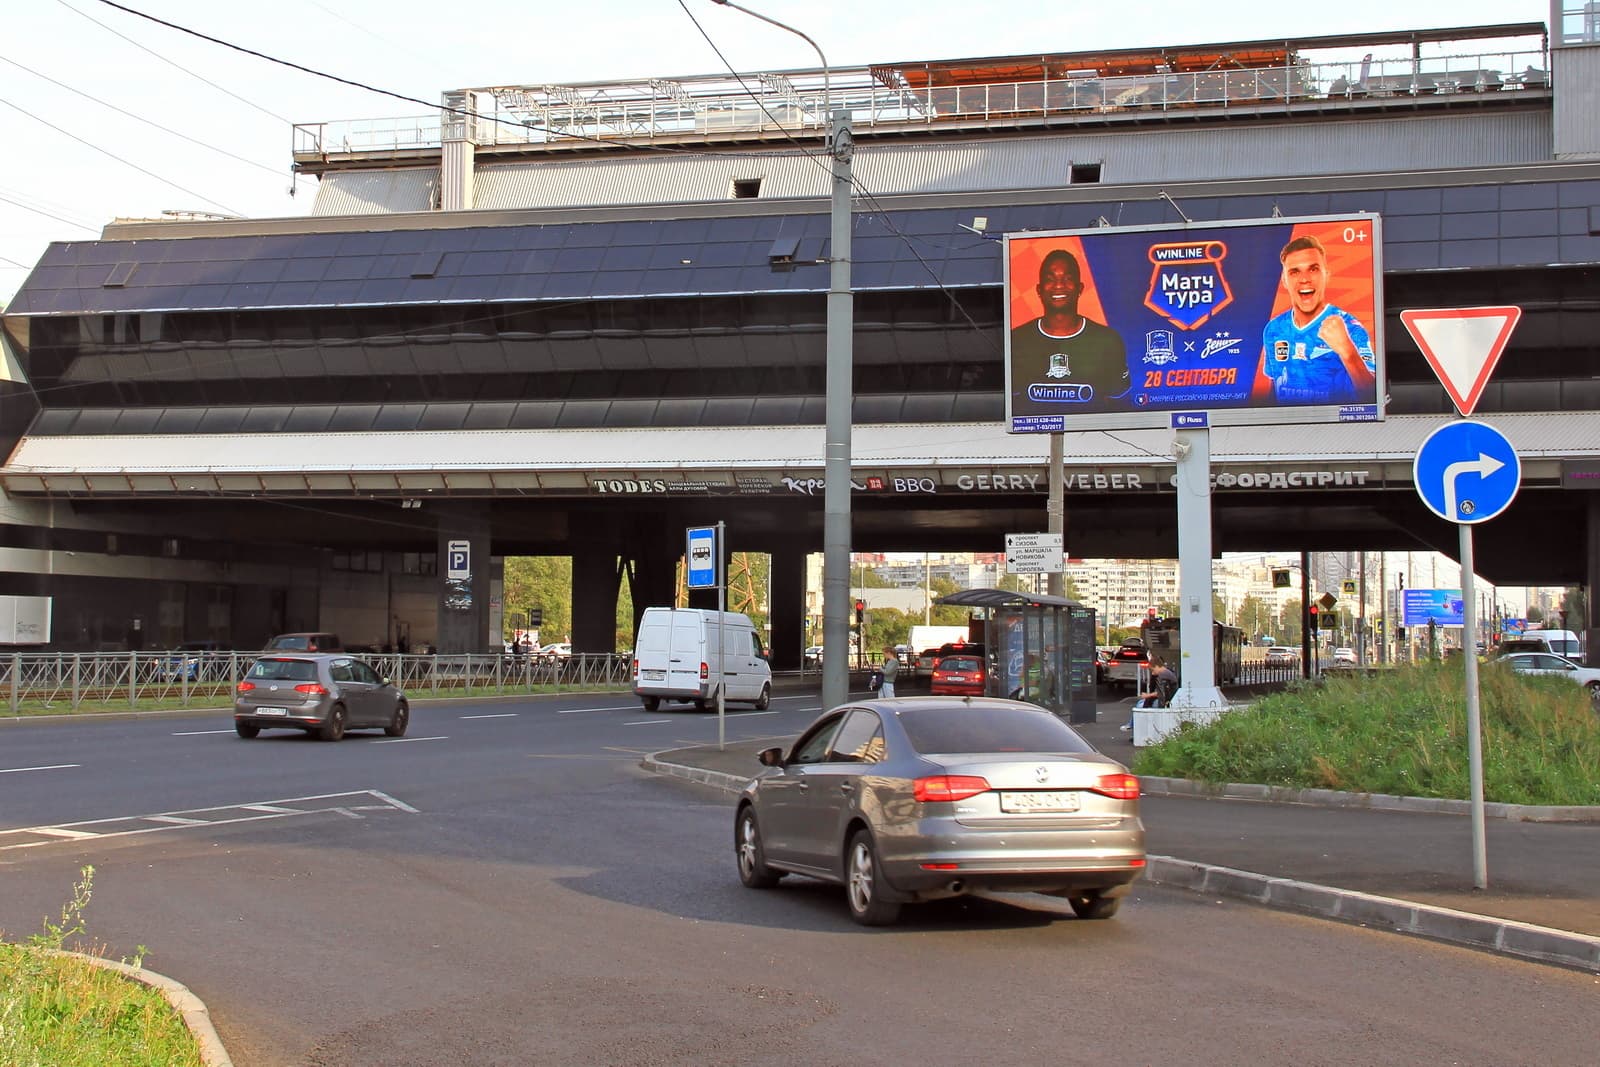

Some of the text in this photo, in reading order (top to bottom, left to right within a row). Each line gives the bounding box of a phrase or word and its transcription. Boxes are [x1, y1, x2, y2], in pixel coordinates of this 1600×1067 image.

[1343, 227, 1368, 243] 0+
[1156, 247, 1203, 260] WINLINE
[1161, 272, 1214, 291] Матч
[1164, 289, 1213, 309] тура
[1144, 367, 1238, 388] 28 СЕНТЯБРЯ
[1032, 387, 1076, 398] Winline
[1186, 416, 1203, 424] Russ
[594, 479, 667, 493] TODES
[894, 478, 936, 493] BBQ
[956, 473, 1039, 490] GERRY
[1170, 470, 1369, 489] ОФОРДСТРИТ
[453, 552, 465, 569] P
